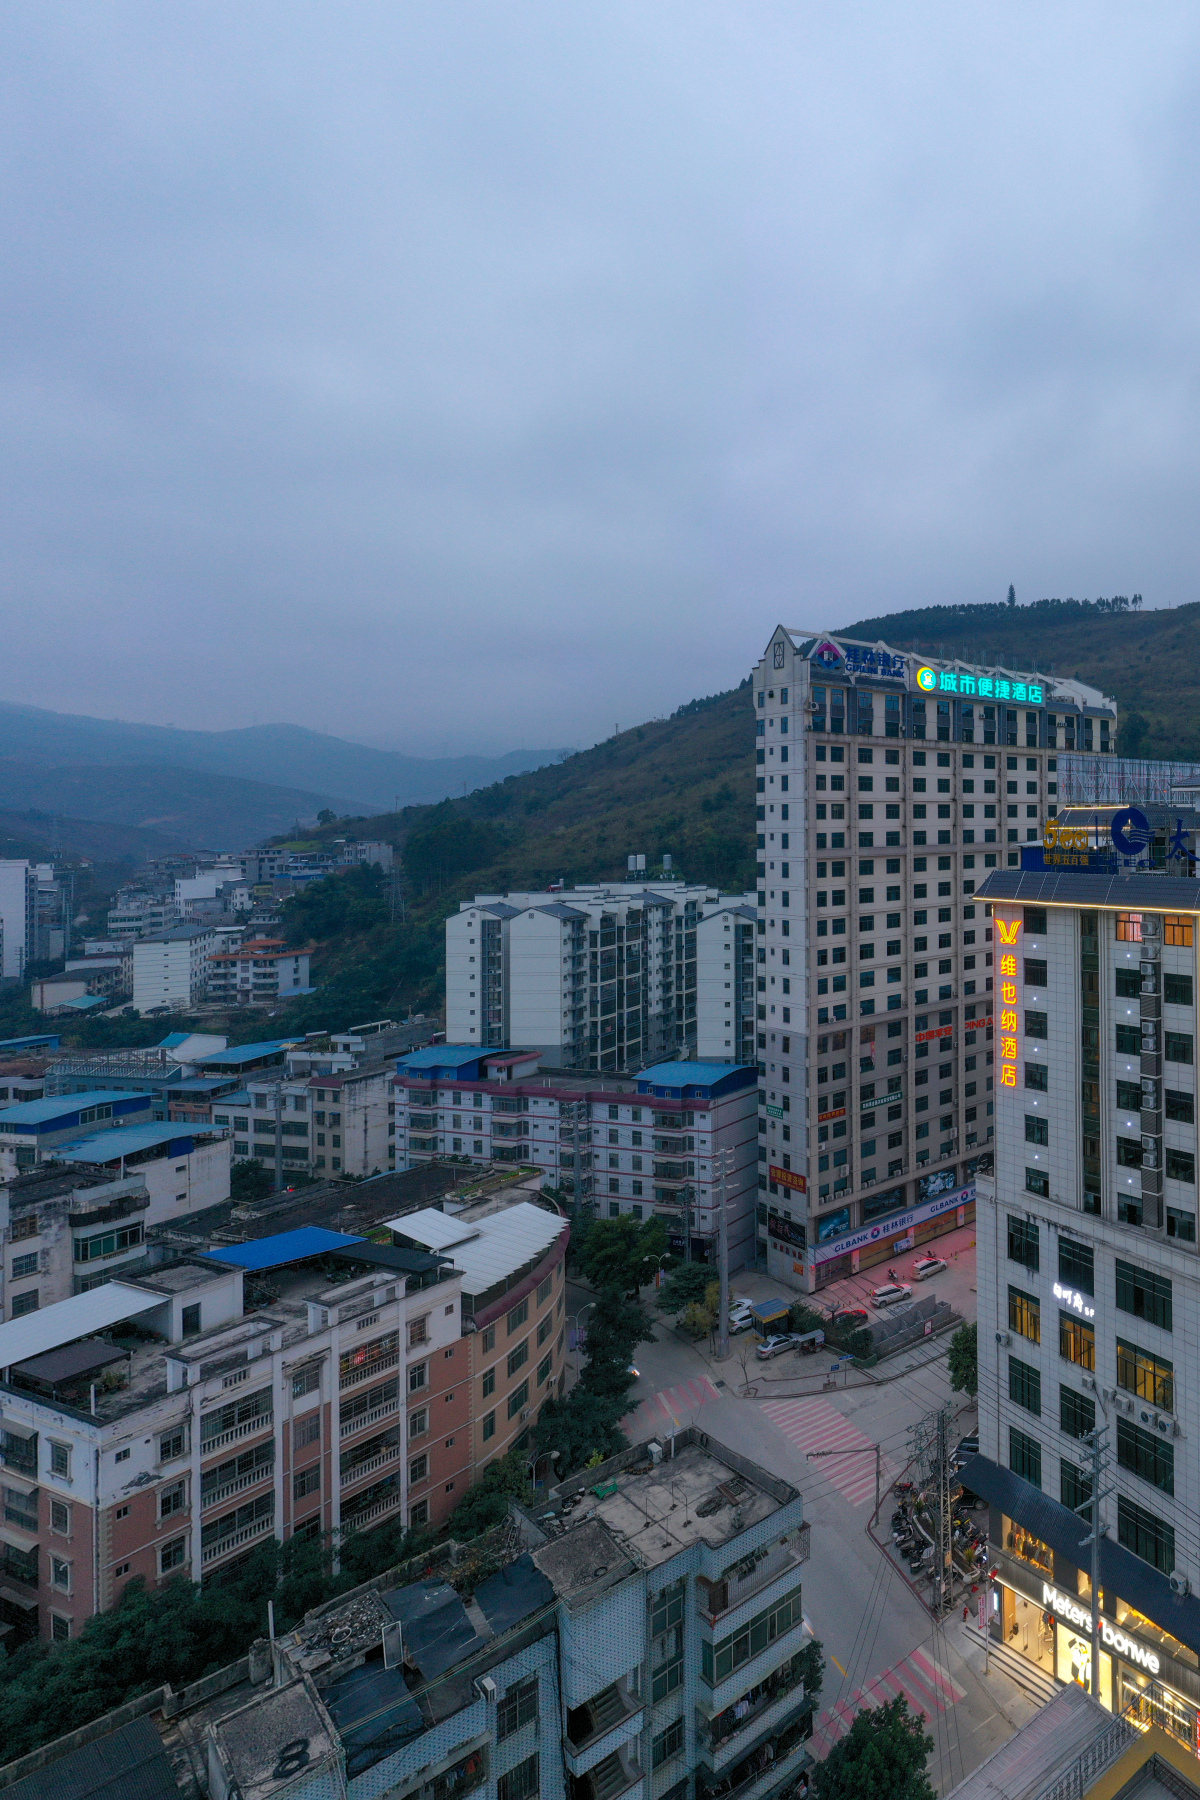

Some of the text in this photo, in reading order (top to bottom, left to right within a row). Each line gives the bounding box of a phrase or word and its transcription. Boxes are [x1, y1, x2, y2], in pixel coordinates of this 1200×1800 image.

[845, 647, 905, 669] 桂林银行
[845, 663, 905, 678] GUILIN BANK
[939, 671, 1042, 703] 城市便捷酒店
[1043, 853, 1089, 866] 世界五百强
[1000, 954, 1017, 1087] 维也纳酒店
[915, 1026, 952, 1042] 中国平安
[930, 1195, 958, 1212] GLBANK
[882, 1214, 913, 1233] 桂林银行
[834, 1233, 869, 1253] GLBANK
